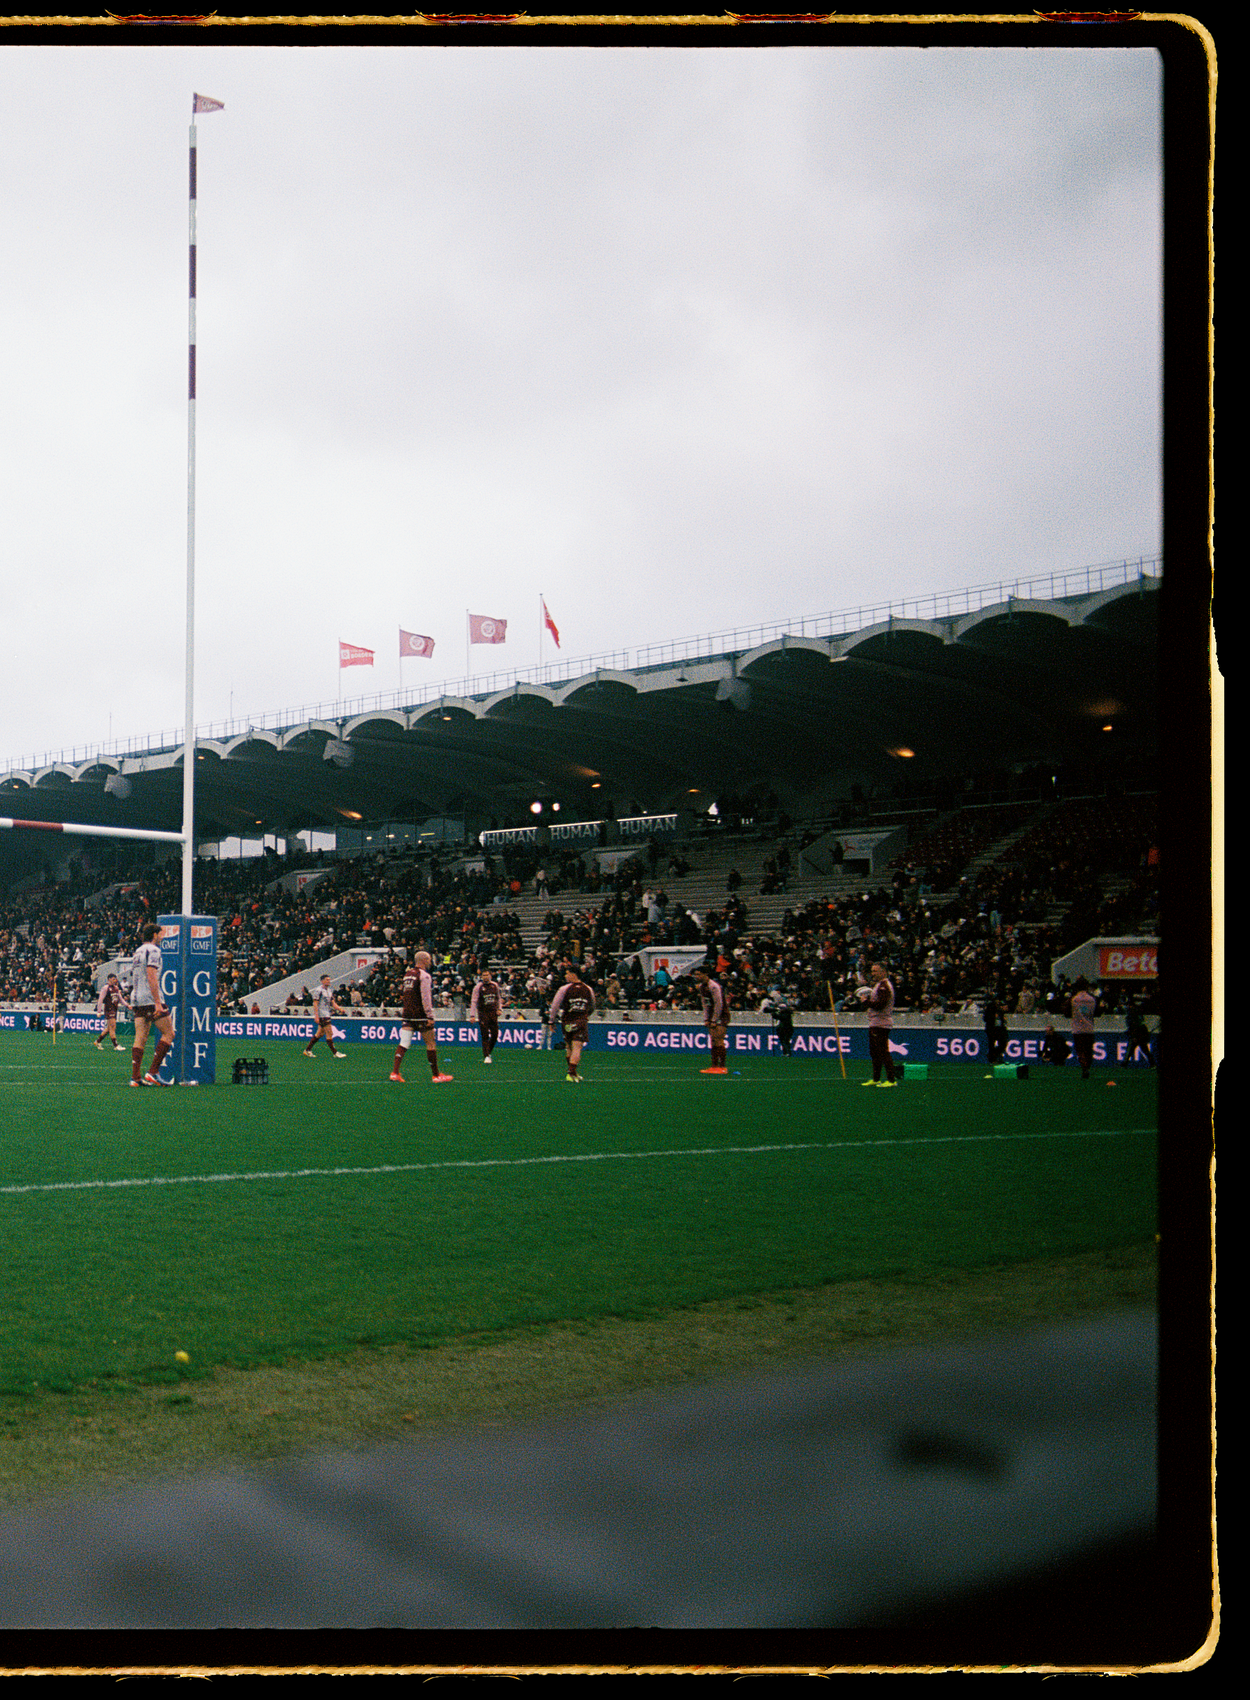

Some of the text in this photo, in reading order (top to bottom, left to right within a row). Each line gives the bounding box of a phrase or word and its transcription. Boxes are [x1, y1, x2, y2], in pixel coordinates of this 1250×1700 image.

[551, 824, 601, 840] HUMAN
[619, 817, 676, 835] HUMAN
[487, 829, 536, 845] HUMAN
[161, 940, 177, 950] GMF
[193, 940, 210, 950] GMF
[63, 1018, 105, 1031] AGENCES
[191, 970, 211, 1068] GMF
[214, 1022, 314, 1037] NCES EN FRANCE
[360, 1026, 386, 1040] 560
[458, 1028, 478, 1042] EN
[497, 1029, 543, 1044] RANCE
[606, 1031, 639, 1047] 560
[735, 1034, 761, 1050] EN
[767, 1034, 851, 1053] FANCE
[936, 1037, 980, 1056] 560
